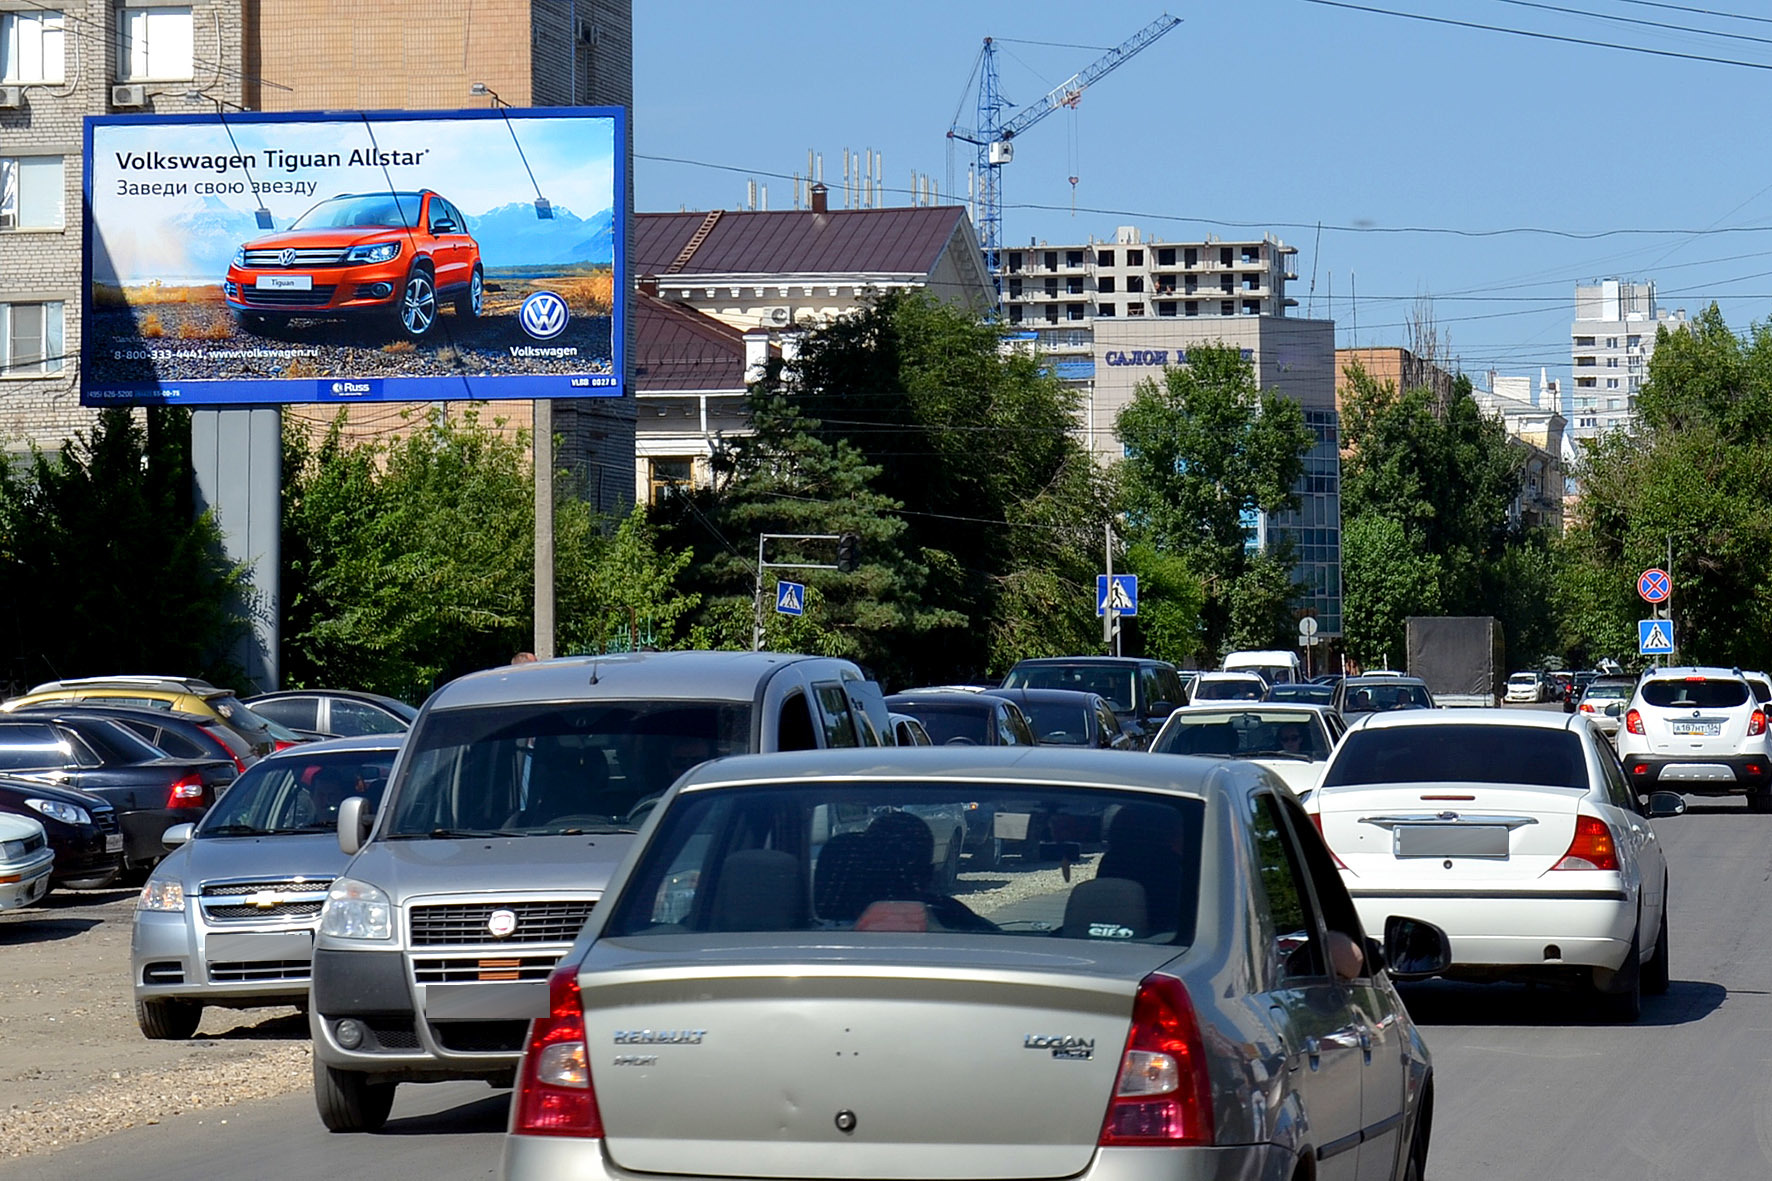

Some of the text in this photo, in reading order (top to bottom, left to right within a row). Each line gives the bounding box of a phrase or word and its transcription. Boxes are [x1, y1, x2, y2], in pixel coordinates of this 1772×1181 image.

[115, 151, 256, 174] Volkswagen
[263, 149, 340, 173] Tiguan
[116, 179, 318, 197] Заведи свою звезду
[271, 278, 295, 287] Tiguan
[208, 347, 319, 359] www.volkswagen.ru
[509, 346, 578, 358] Volkswagen
[1105, 350, 1168, 366] САЛОН
[344, 382, 370, 392] Russ
[614, 1028, 706, 1045] RENAULT
[1023, 1032, 1095, 1050] LOGAN
